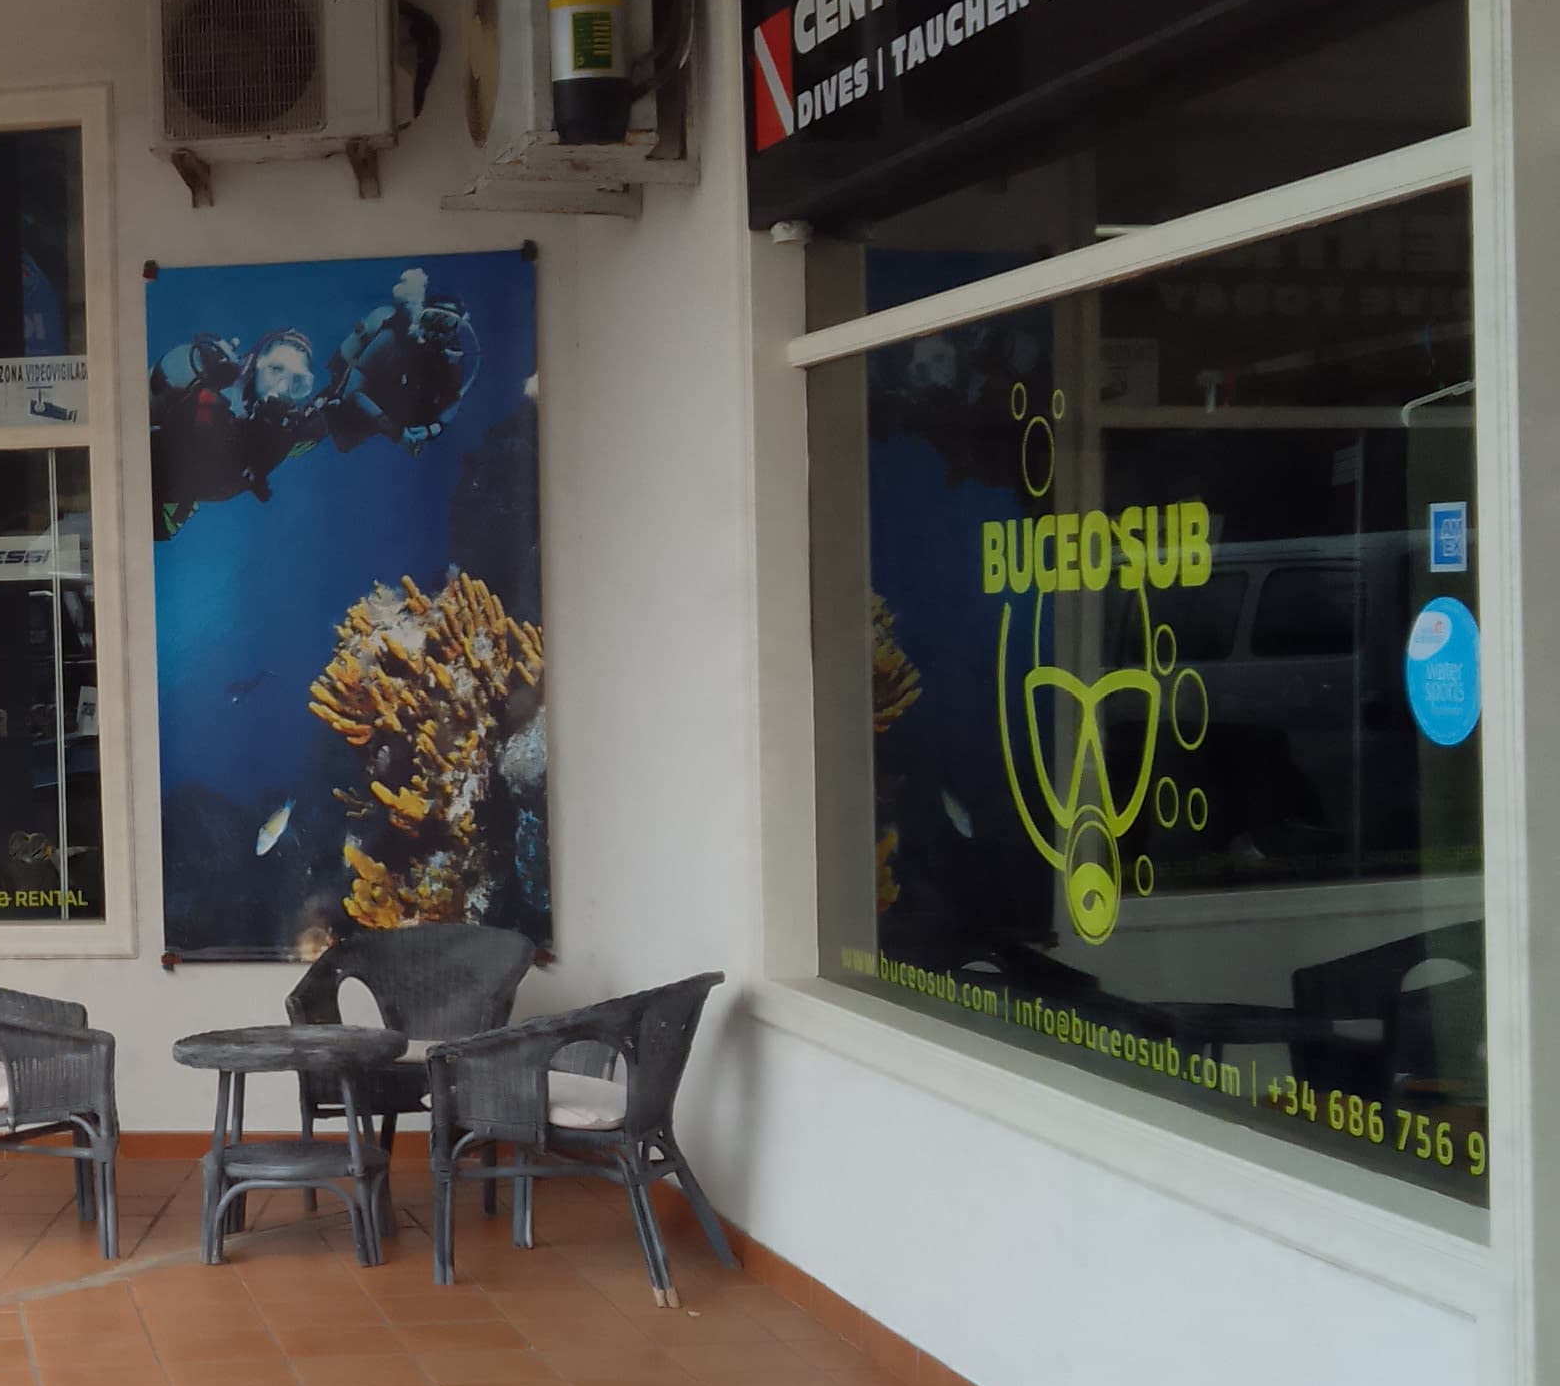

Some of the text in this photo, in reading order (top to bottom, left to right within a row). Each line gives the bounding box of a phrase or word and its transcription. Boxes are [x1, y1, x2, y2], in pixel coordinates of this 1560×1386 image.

[797, 57, 869, 129] DIVES
[25, 362, 88, 382] VIDEOVIGILAD
[983, 501, 1212, 594] BUCEO SUB
[15, 889, 88, 908] RENTAL
[842, 947, 997, 1015] www.buceosub.com
[1015, 997, 1241, 1097] info@buceosub.com
[1267, 1075, 1317, 1122] +34
[1328, 1090, 1383, 1144] 686
[1397, 1109, 1453, 1166] 756
